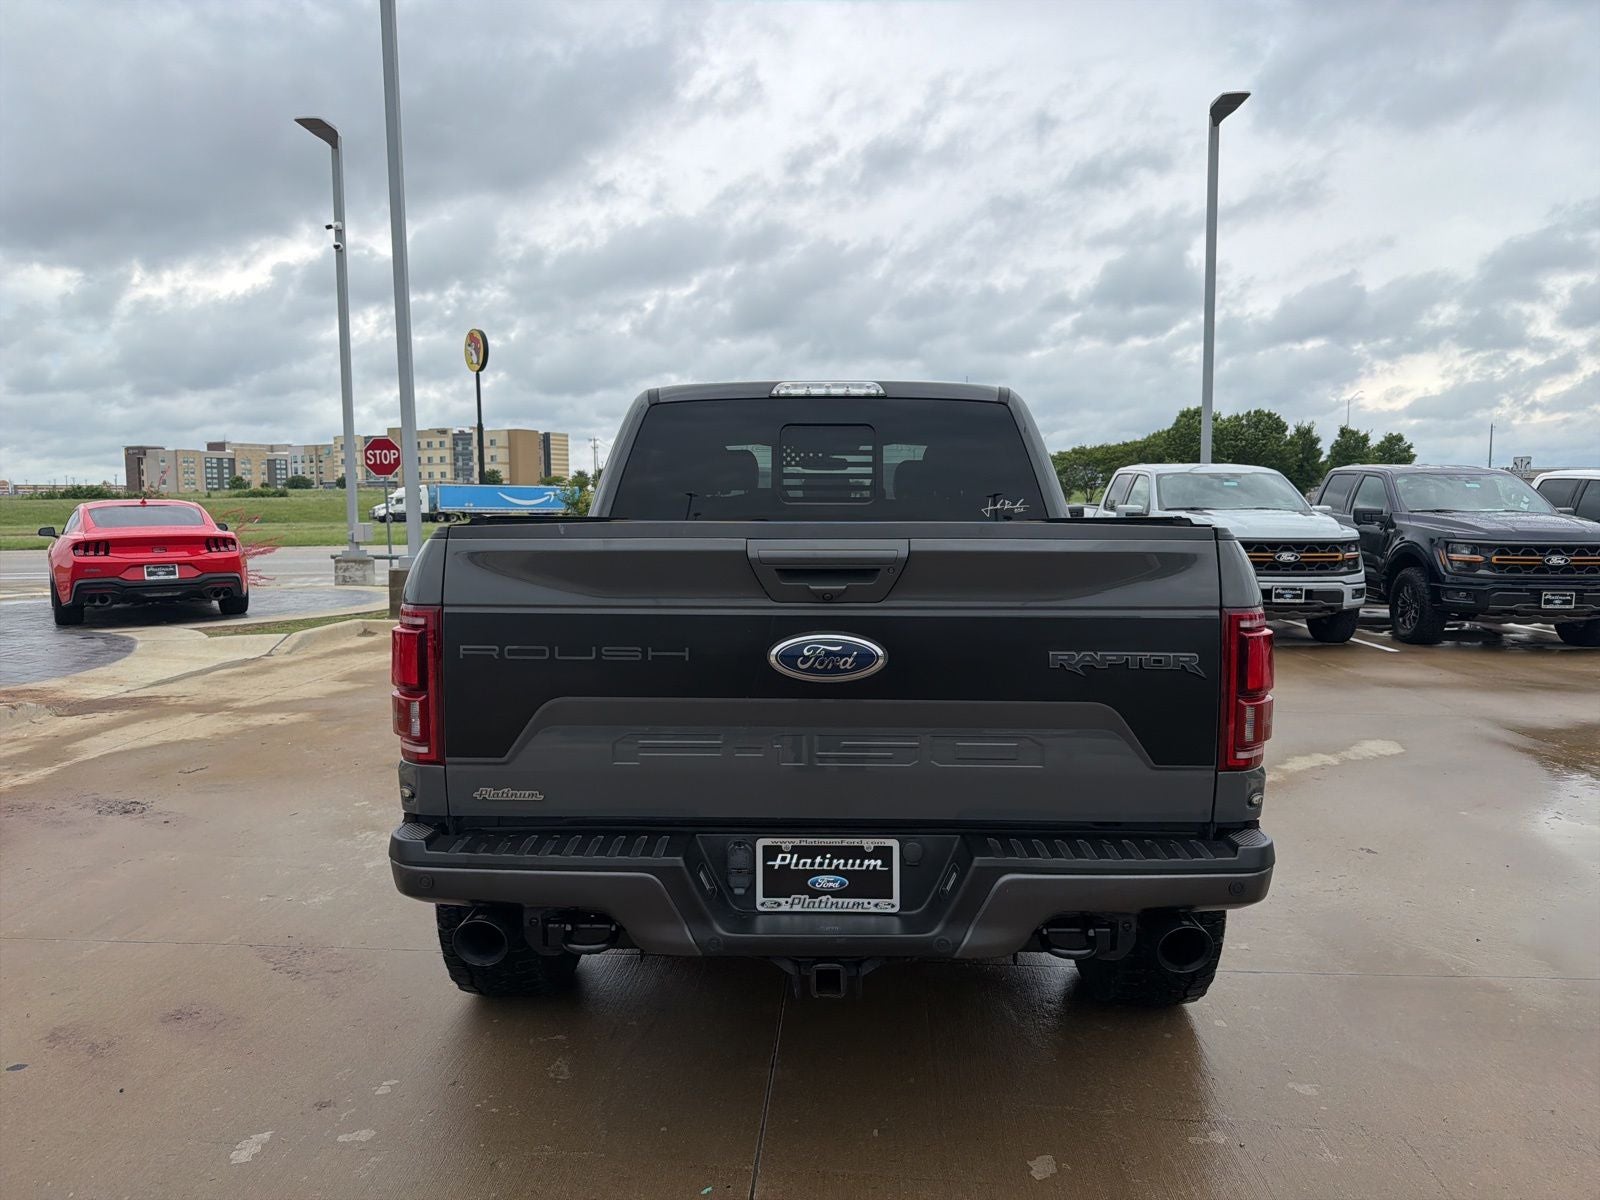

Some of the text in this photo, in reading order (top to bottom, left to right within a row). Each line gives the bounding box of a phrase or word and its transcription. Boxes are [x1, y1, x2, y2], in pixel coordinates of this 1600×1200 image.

[366, 450, 399, 465] STOP
[459, 644, 690, 662] ROUSH
[796, 644, 858, 670] Ford
[1048, 650, 1207, 679] RAPTOR
[612, 733, 1045, 768] F-150
[472, 787, 545, 801] Platinum
[766, 853, 889, 871] Platinum
[815, 878, 841, 888] Ford
[789, 896, 871, 911] Platinum
